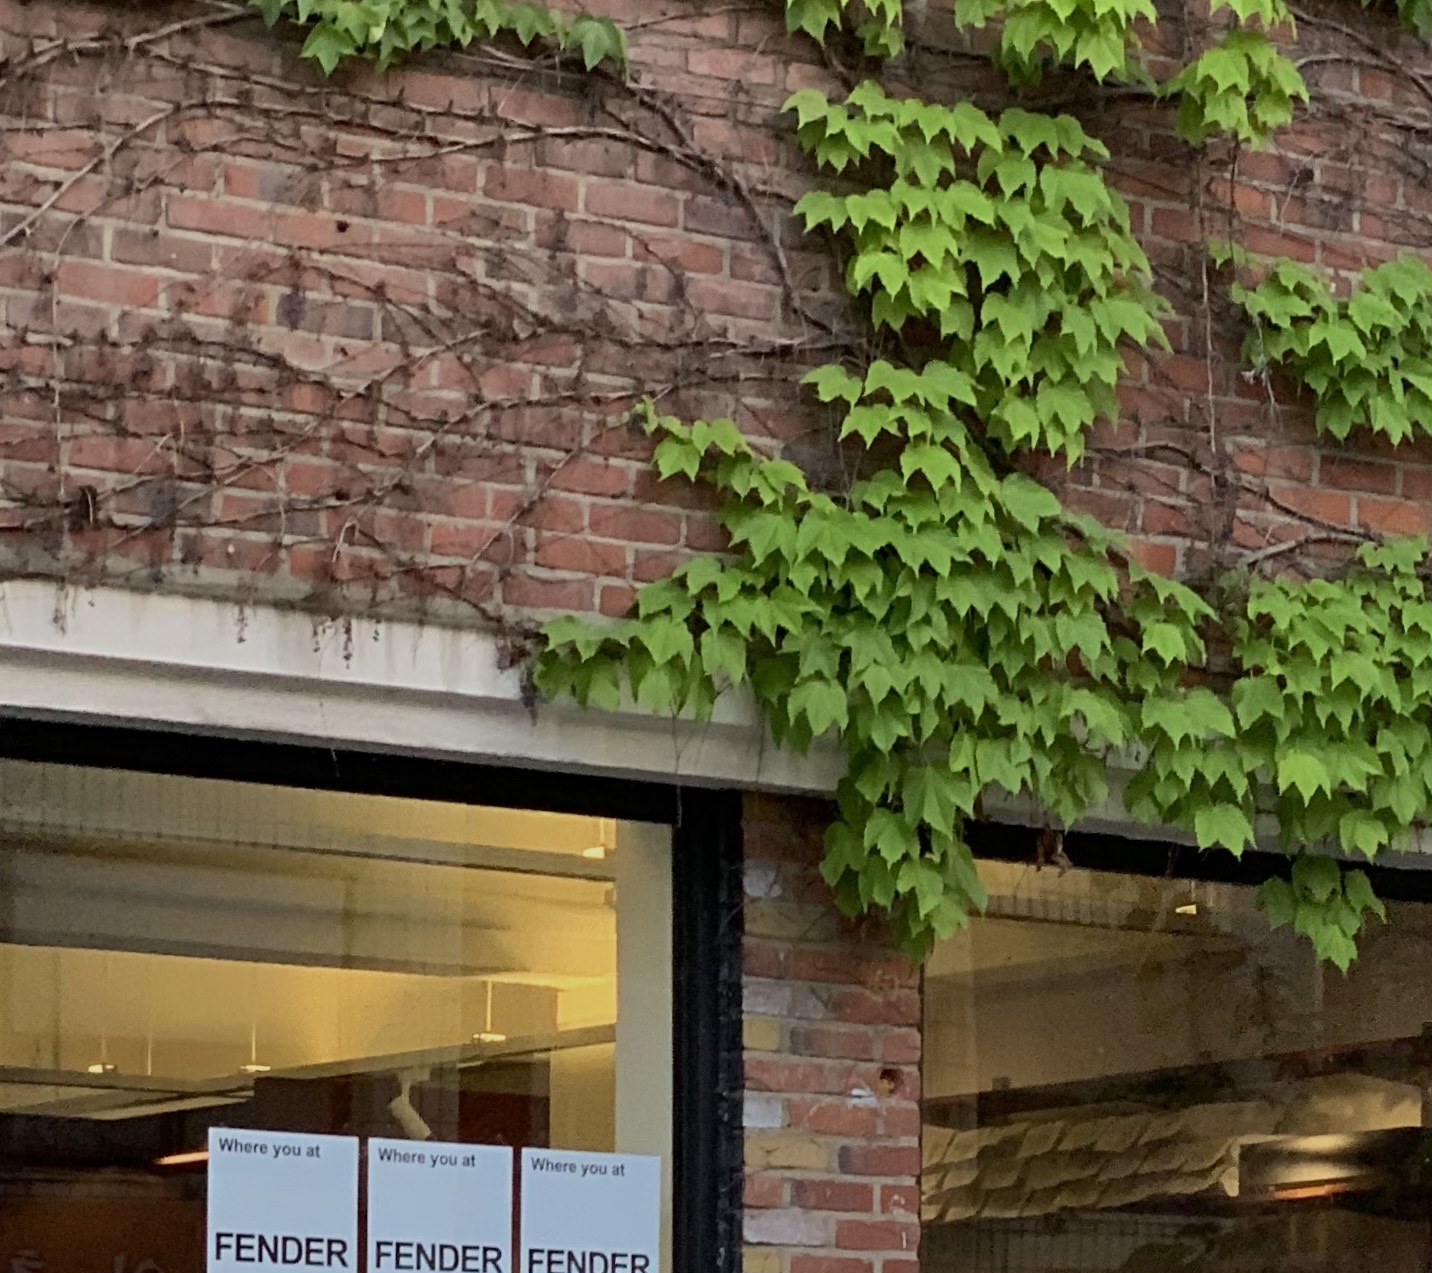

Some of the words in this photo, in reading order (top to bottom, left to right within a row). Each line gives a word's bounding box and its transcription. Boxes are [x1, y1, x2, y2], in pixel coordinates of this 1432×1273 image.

[218, 1137, 268, 1156] Where
[272, 1142, 302, 1159] you
[305, 1143, 321, 1158] at
[378, 1148, 425, 1165] Where
[430, 1153, 459, 1169] you
[462, 1153, 476, 1168] at
[531, 1157, 577, 1174] Where
[580, 1162, 608, 1178] you
[611, 1162, 625, 1177] at
[215, 1231, 348, 1268] FENDER
